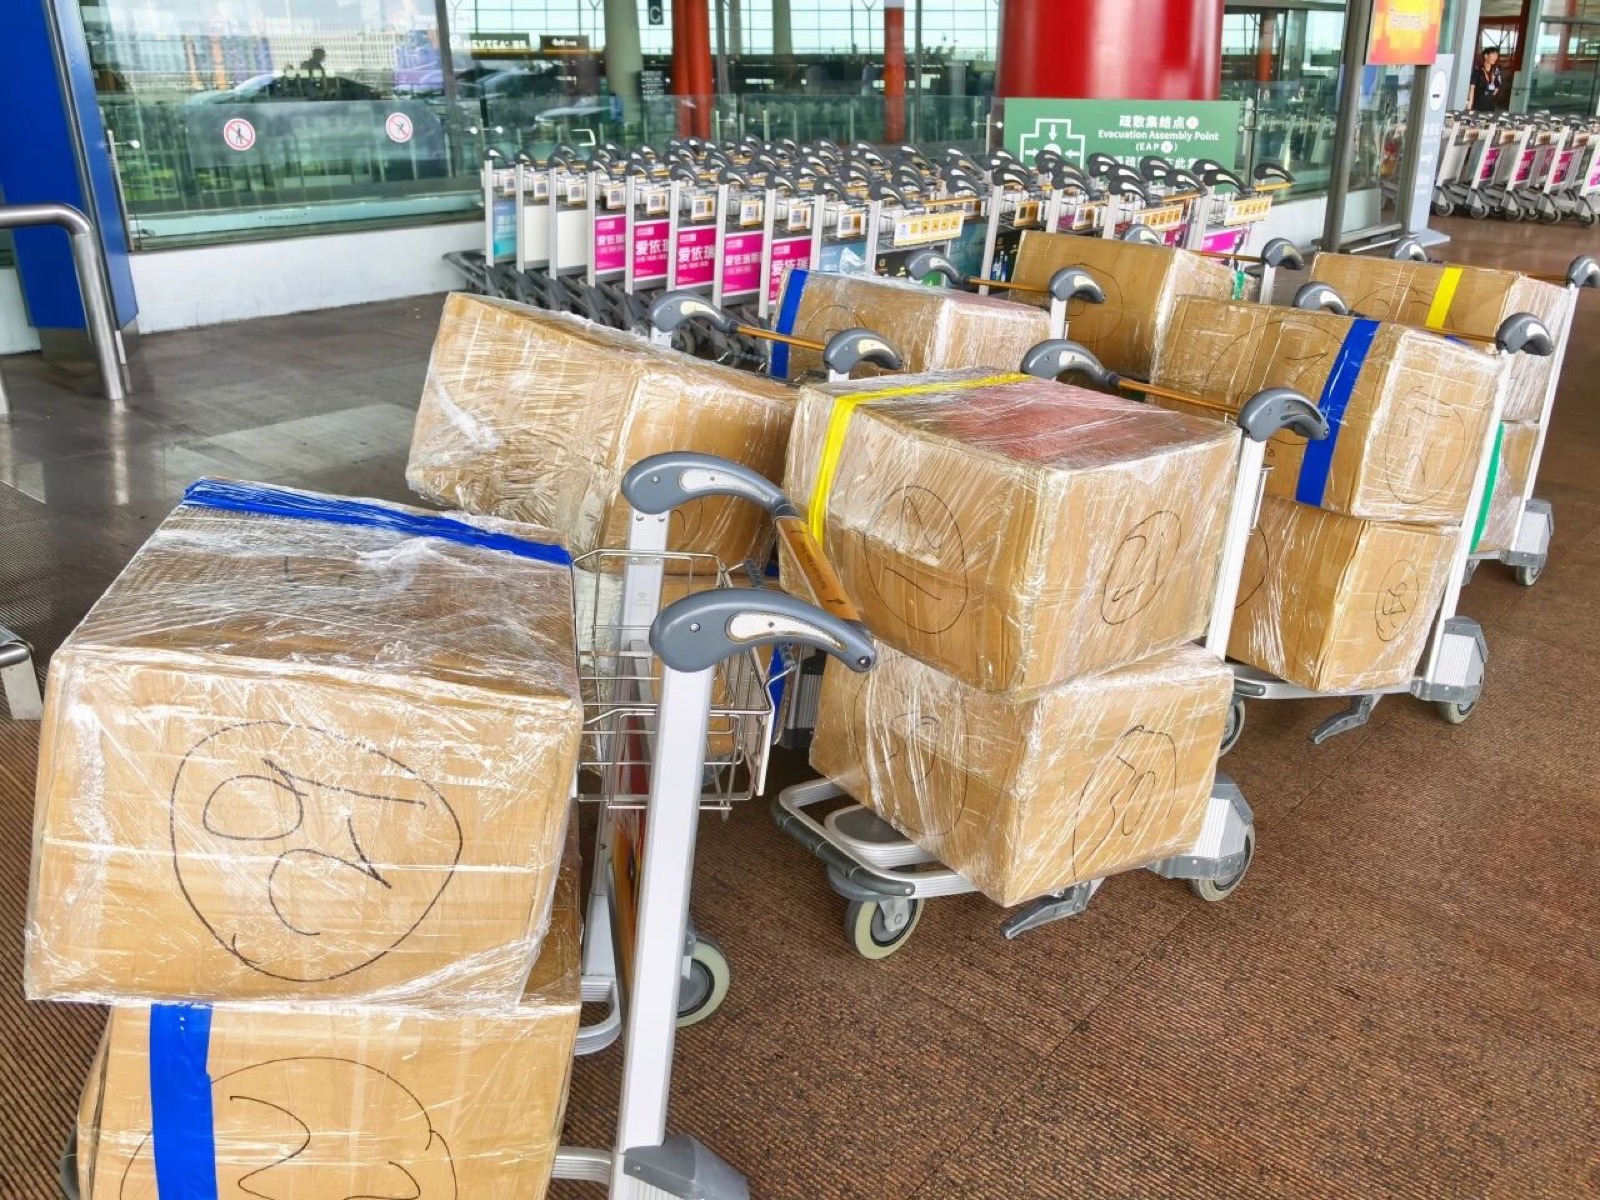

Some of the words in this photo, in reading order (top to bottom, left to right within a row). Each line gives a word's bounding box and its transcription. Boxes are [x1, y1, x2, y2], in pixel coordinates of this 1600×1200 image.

[650, 6, 662, 24] C
[1098, 129, 1147, 139] Evacuation
[1149, 130, 1193, 141] Assembly
[1194, 131, 1219, 141] Point
